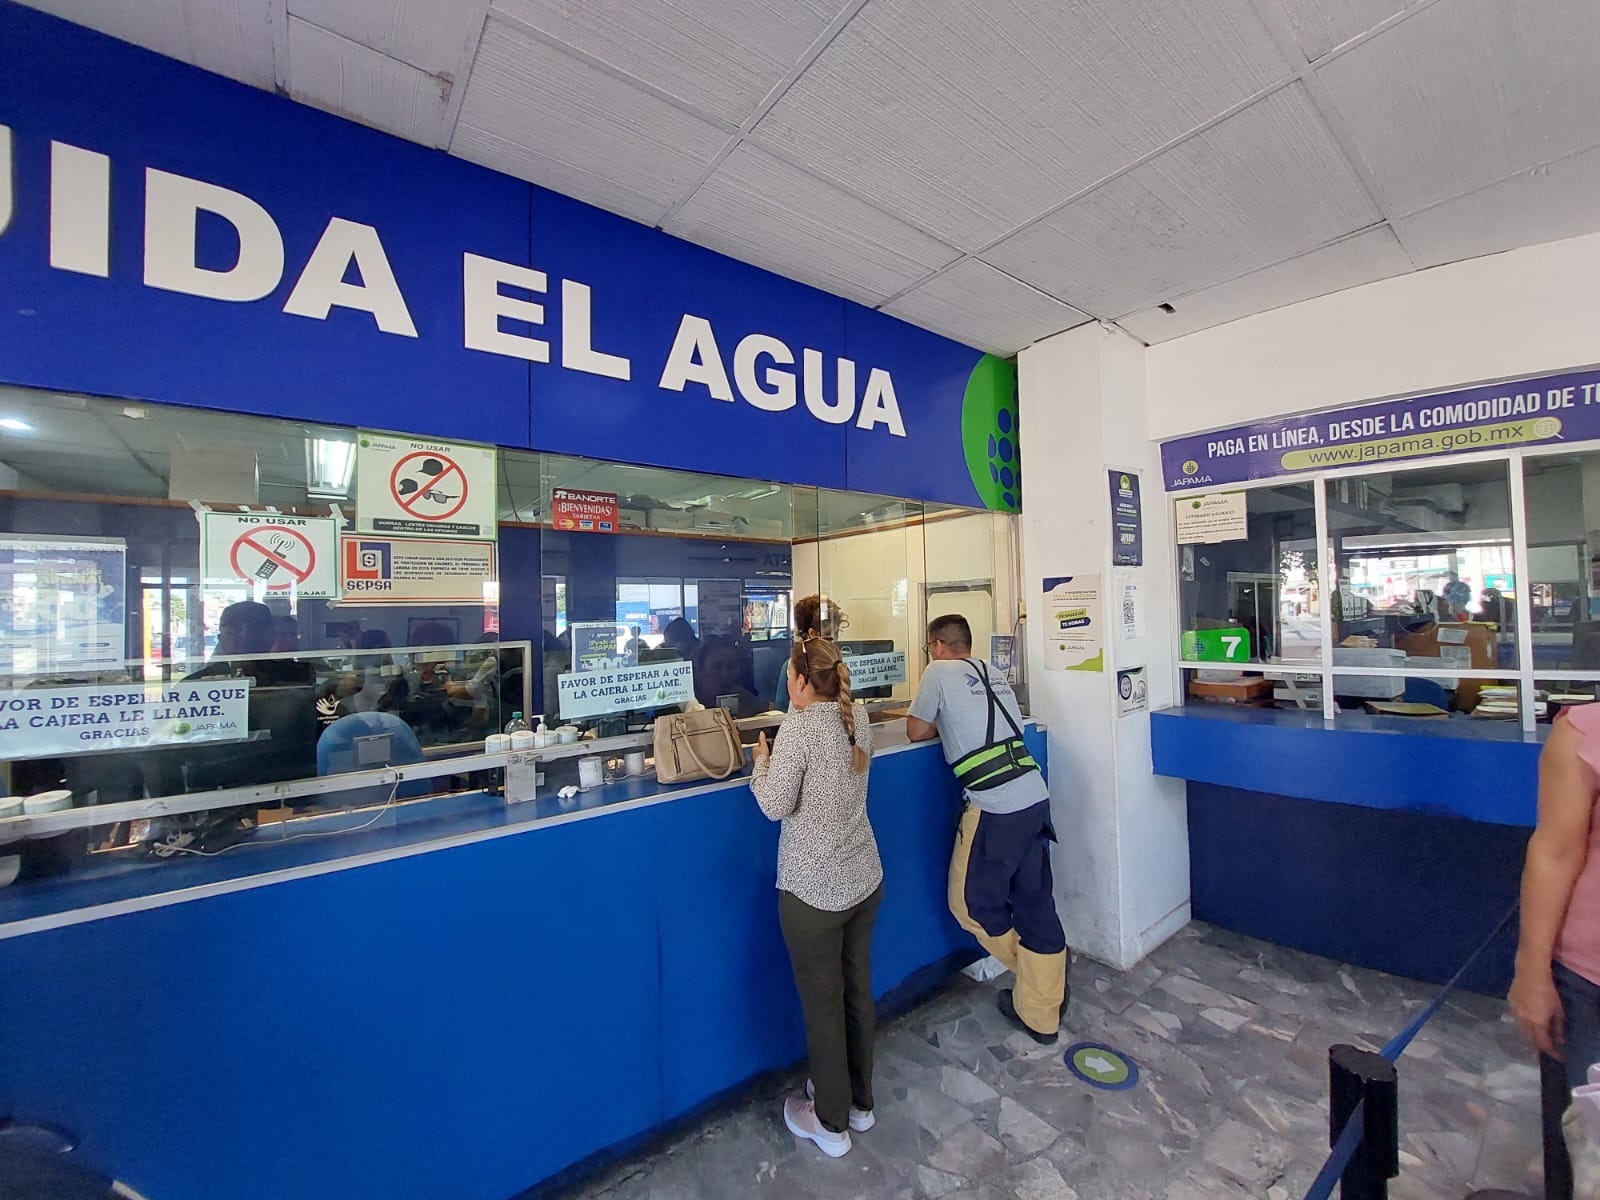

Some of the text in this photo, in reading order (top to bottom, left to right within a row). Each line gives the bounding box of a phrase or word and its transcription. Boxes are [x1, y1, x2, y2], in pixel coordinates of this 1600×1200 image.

[0, 123, 907, 437] IDA EL AGUA
[1207, 440, 1245, 459] PAGA
[1248, 435, 1268, 452] EN
[1272, 426, 1325, 449] LÍNEA,
[1329, 415, 1385, 441] DESDE
[1390, 411, 1415, 433] LA
[1419, 392, 1541, 428] COMODIDAD
[1547, 386, 1576, 411] DE
[410, 442, 451, 453] NO USAR
[1308, 425, 1523, 464] www.japama.gob.mx
[1170, 475, 1213, 488] JAPAMA
[567, 493, 616, 505] BANORTE
[558, 502, 613, 517] ¡BIENVENIDAS!
[346, 580, 392, 591] SEPSA
[1221, 636, 1242, 658] 7
[892, 655, 905, 664] QUE
[561, 666, 691, 689] FAVOR DE ESPERAR A QUE
[573, 679, 682, 699] LA CAJERA LE LLAME.
[51, 696, 79, 709] DE
[188, 692, 201, 702] A
[207, 688, 246, 701] QUE
[614, 695, 647, 704] GRACIAS
[29, 712, 111, 728] CAJERA
[119, 710, 144, 723] LE
[152, 705, 225, 720] LLAME.
[79, 727, 150, 740] GRACIAS
[191, 721, 238, 732] JAPAMA
